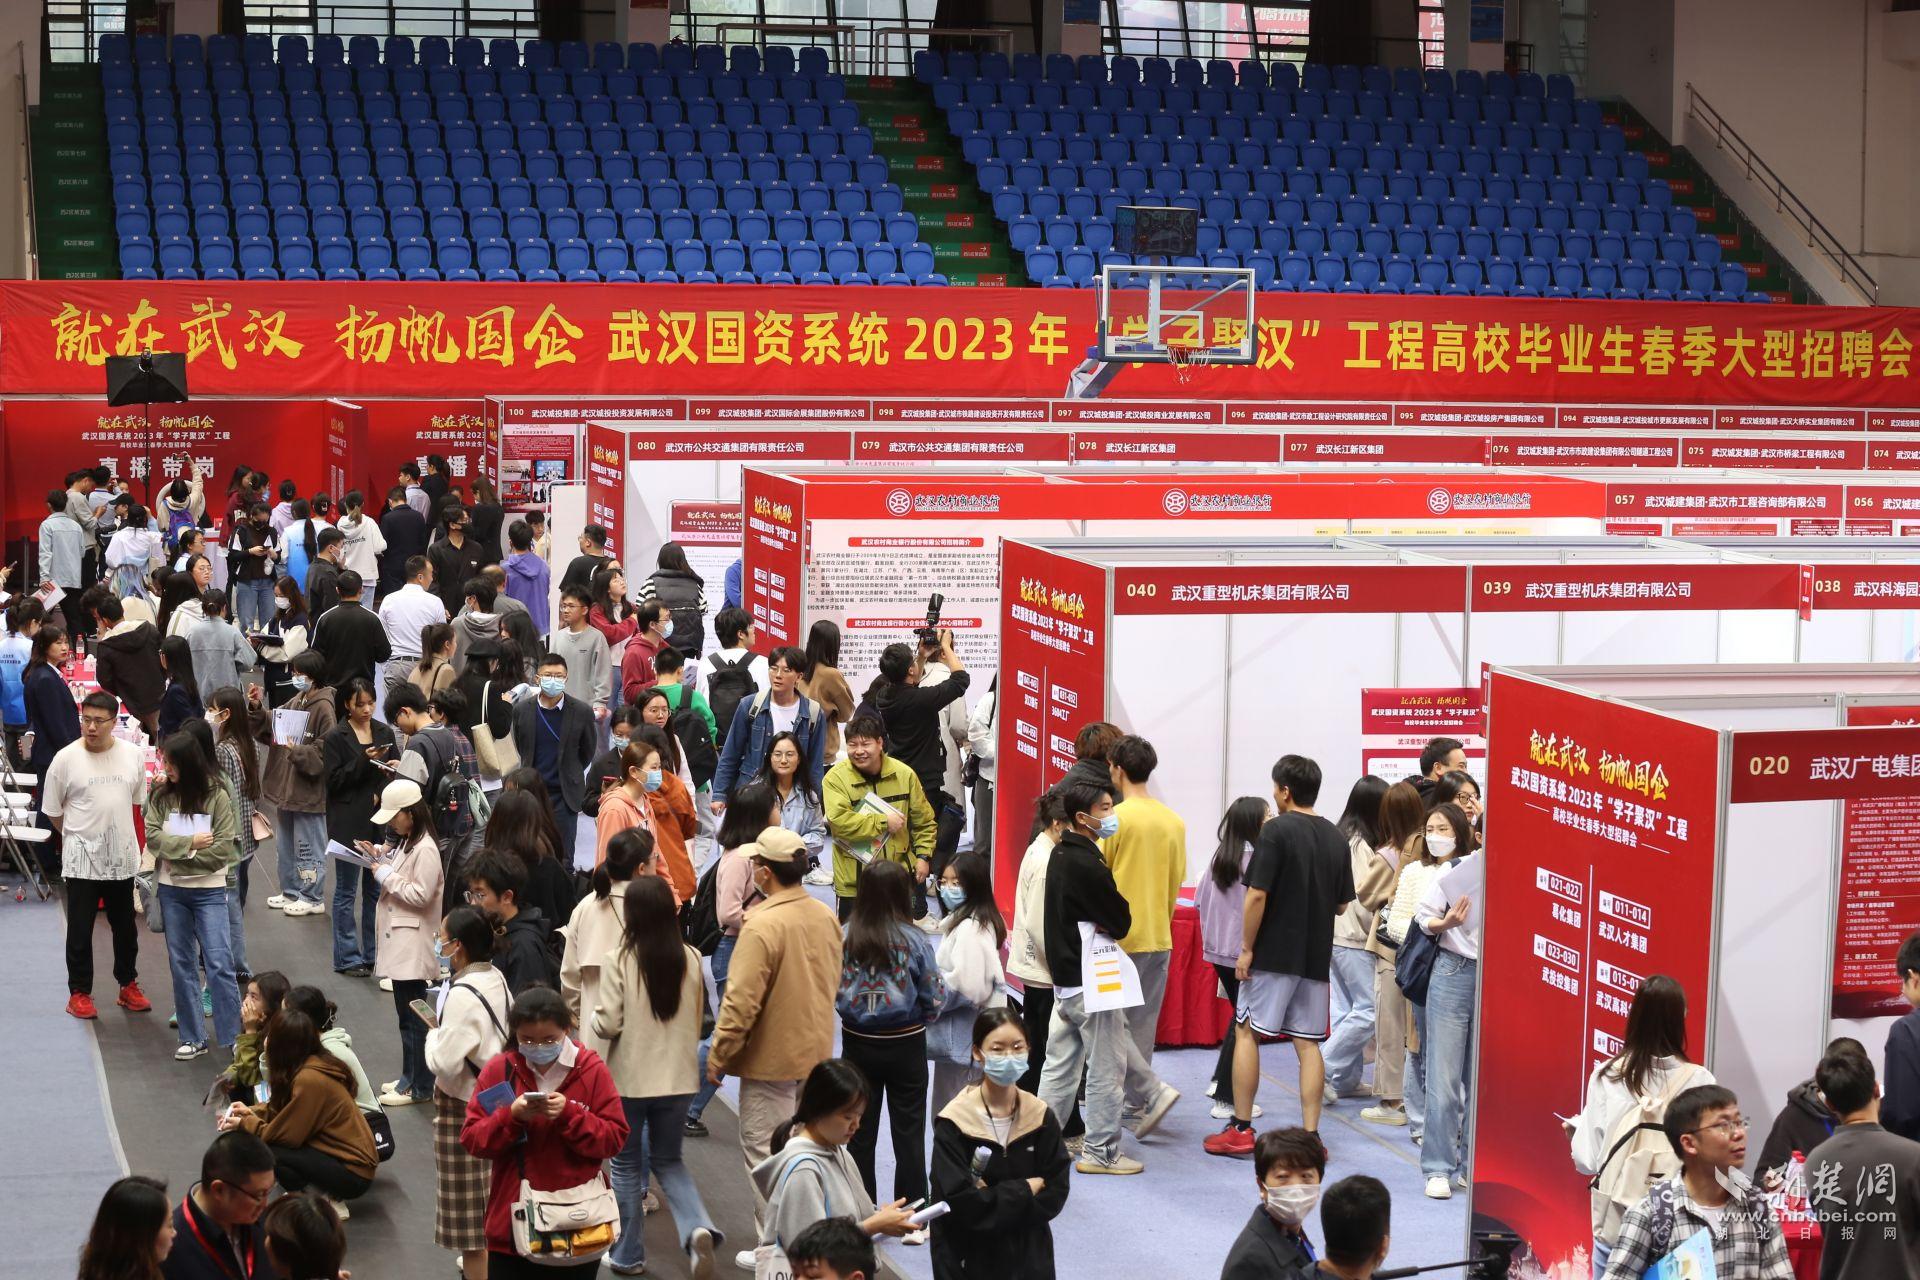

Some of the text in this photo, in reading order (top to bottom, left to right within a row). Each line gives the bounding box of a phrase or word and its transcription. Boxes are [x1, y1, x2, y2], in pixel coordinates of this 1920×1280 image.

[51, 297, 304, 370] 就在武汉
[335, 303, 584, 369] 扬帆国企
[608, 309, 889, 366] 武汉国资系统
[904, 316, 1015, 362] 2023
[1028, 312, 1068, 366] 年
[1344, 319, 1912, 380] 工程高校毕业生春季大型招聘会
[531, 409, 673, 418] 武汉城投集团·武汉城投投资发展有限公司
[695, 408, 865, 419] 099 武汉城投集团·武汉国际会展集团股份有限公司
[1079, 411, 1211, 420] 武汉城投集团·武汉城投商业发展有限公司
[1420, 413, 1544, 423] 武汉城投集团·武汉城投房产集团有限公司
[1582, 415, 1709, 425] 武汉城投集团·武汉城投城市更新发展有限公司
[97, 414, 215, 429] 就在武汉 扬帆国企
[1740, 417, 1855, 426] 武汉城投集团·武汉大桥实业集团有限公司
[214, 432, 230, 440] 工程
[637, 441, 804, 453] 080 武汉市公共交通集团有限责任公司
[862, 441, 1024, 454] 079 武汉市公共交通集团有限责任公司
[1080, 441, 1176, 454] 078 武汉长江新区集团
[1290, 443, 1384, 454] 077 武汉长江新区集团
[1492, 445, 1509, 453] 076
[1688, 446, 1845, 459] 075 武汉城发集团·武汉市桥梁工程有限公司
[1874, 449, 1920, 460] 074 武汉城
[915, 494, 1000, 507] 武汉农村商业银行
[1615, 494, 1826, 508] 057 武汉城建集团·武汉市工程咨询部有限公司
[1854, 497, 1874, 507] 056
[1126, 583, 1350, 601] 040 武汉重型机床集团有限公司
[1483, 581, 1691, 598] 039 武汉重型机床集团有限公司
[1815, 580, 1841, 592] 038
[1853, 581, 1920, 597] 武汉科海园
[1020, 576, 1048, 609] 就在武汉
[1050, 588, 1085, 620] 扬帆国企
[1530, 729, 1669, 801] 就在武汉 扬帆国企
[1750, 756, 1790, 776] 020
[1510, 766, 1688, 842] 武汉国资系统 2023 年 “学子聚汉” 工程
[1552, 806, 1638, 848] 高校毕业生春季大型招聘会
[1550, 876, 1580, 899] 021-022
[1615, 900, 1647, 923] 011-014
[1598, 921, 1648, 954] 武汉人才集团
[1547, 945, 1576, 967] 023-030
[1612, 970, 1639, 990] 015-01
[1596, 990, 1632, 1018] 武汉高科
